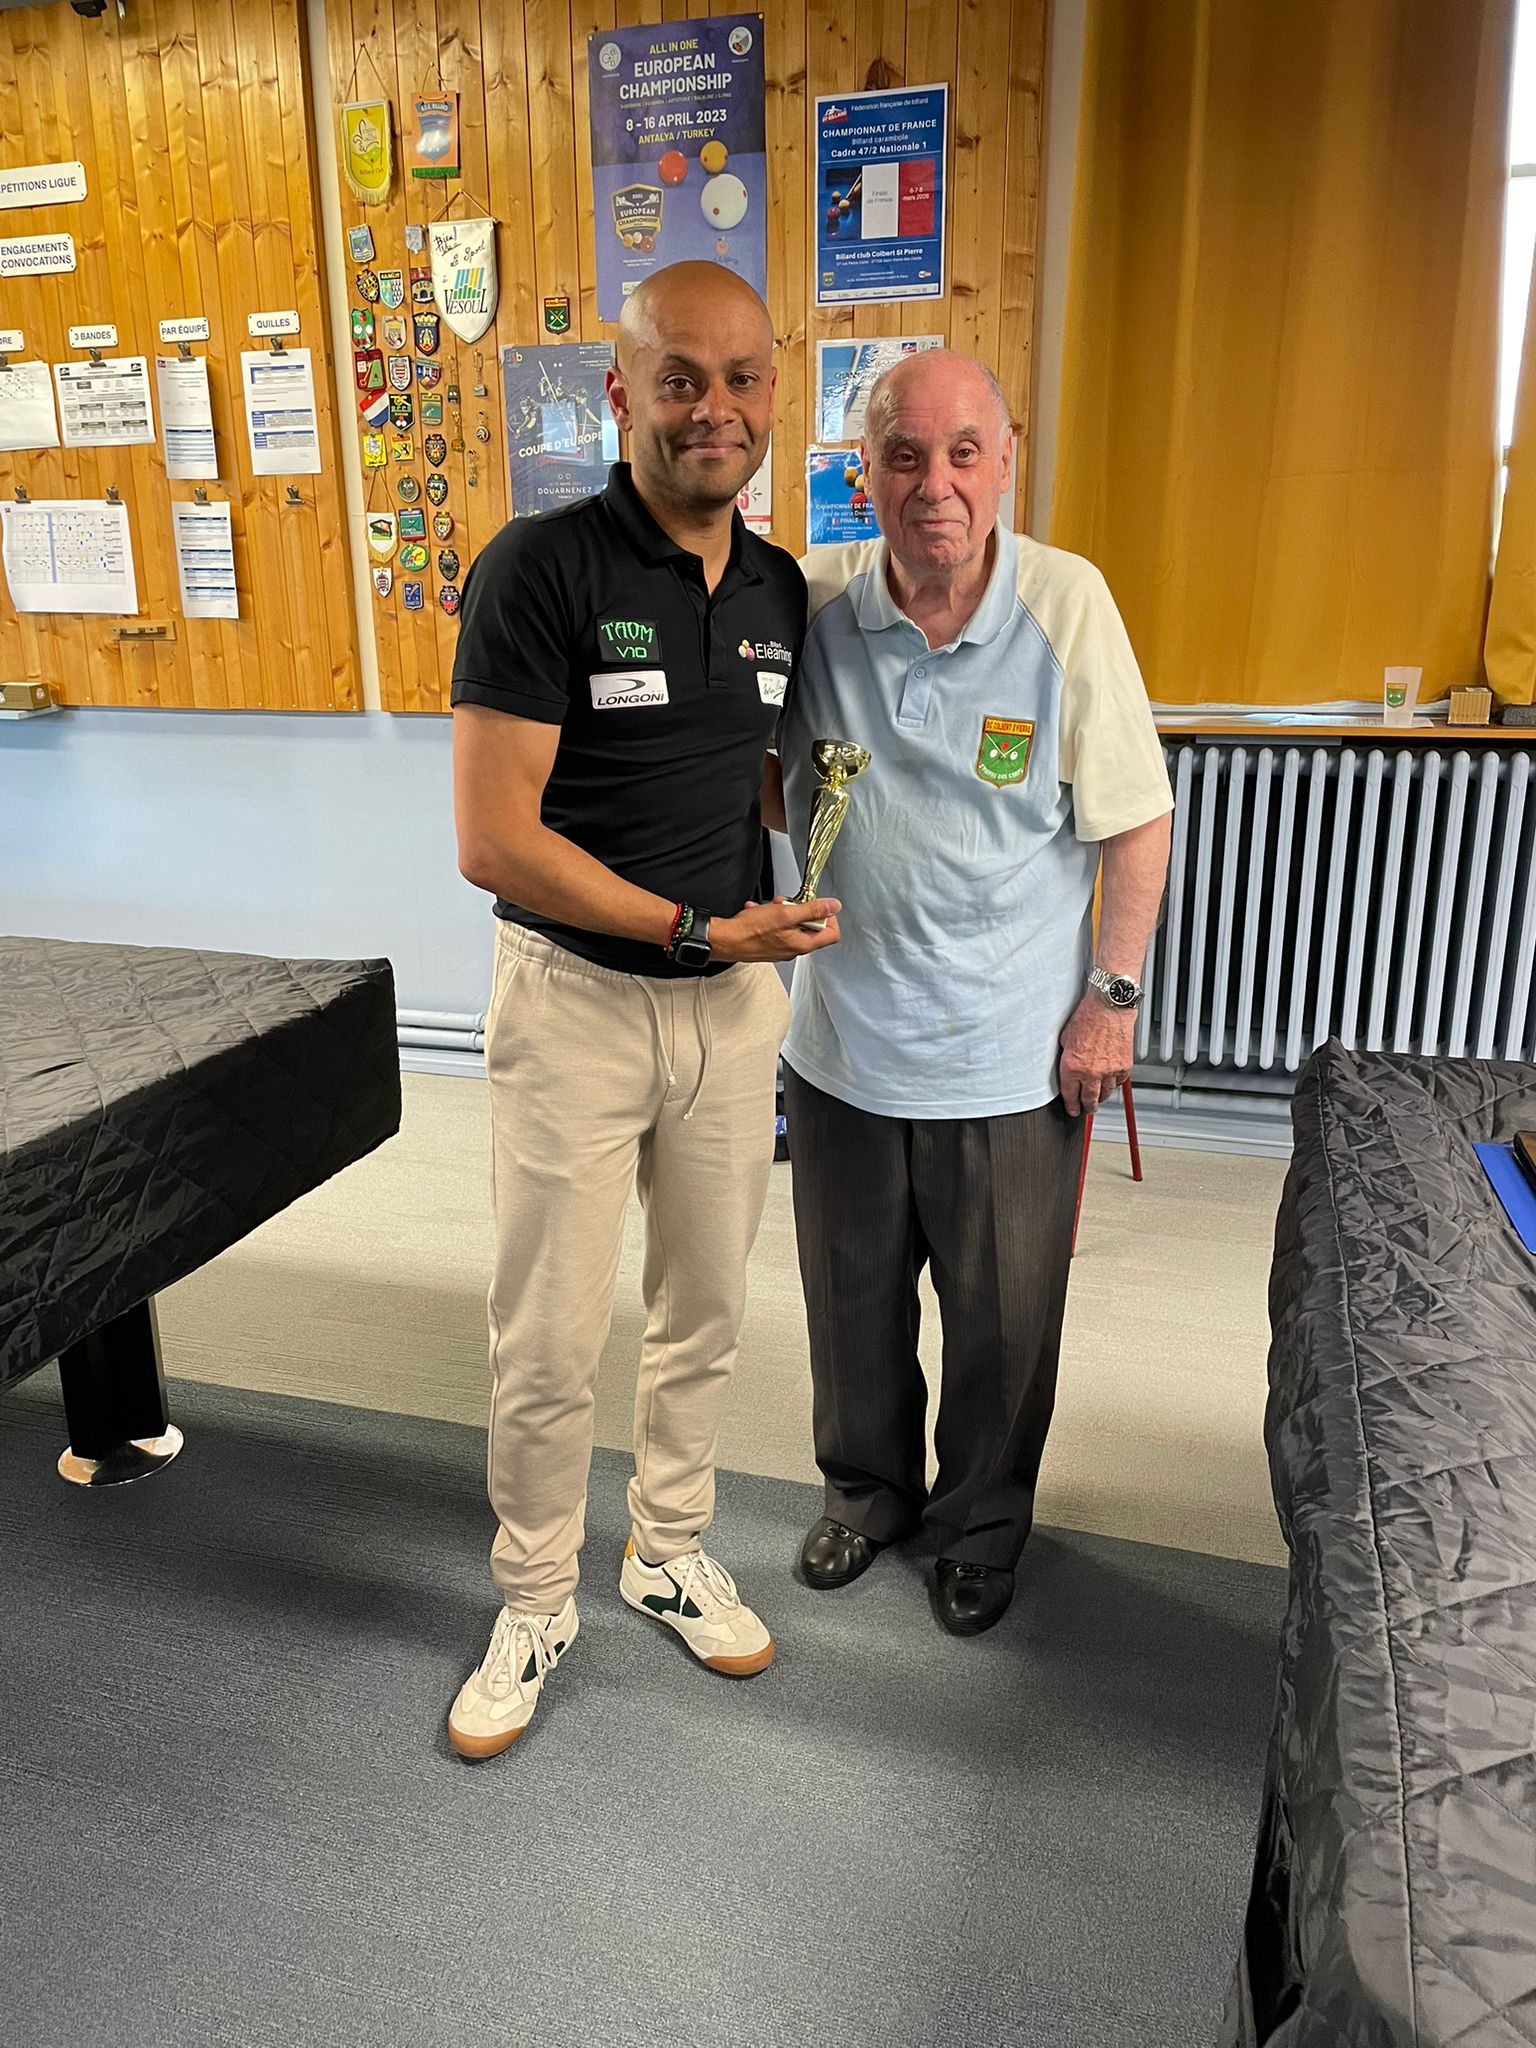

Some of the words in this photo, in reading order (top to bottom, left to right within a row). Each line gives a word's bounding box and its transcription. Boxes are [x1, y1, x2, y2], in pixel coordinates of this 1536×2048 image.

[649, 43, 667, 55] ALL
[669, 41, 678, 51] IN
[680, 39, 698, 50] ONE
[634, 53, 715, 78] EUROPEAN
[619, 73, 732, 100] CHAMPIONSHIP
[626, 119, 633, 131] 8
[644, 117, 655, 129] 16
[658, 113, 693, 128] APRIL
[697, 109, 727, 123] 2023
[823, 125, 886, 138] CHAMPIONNAT
[889, 124, 900, 132] DE
[902, 119, 937, 130] FRANCE
[638, 132, 675, 144] ANTALYA
[682, 128, 715, 139] TURKEY
[852, 137, 873, 145] Billard
[874, 134, 908, 144] carambole
[831, 149, 856, 158] Cadre
[858, 147, 877, 155] 47/2
[880, 143, 920, 154] Nationale
[0, 179, 47, 193] PÉTITIONS
[49, 177, 77, 188] LIGUE
[620, 207, 657, 217] EUROPEAN
[1, 242, 69, 256] ENGAGEMENTS
[835, 252, 856, 260] Billard
[872, 249, 895, 258] Colbert
[1, 255, 72, 269] CONVOCATIONS
[444, 288, 488, 315] VESOUL
[161, 327, 177, 336] PAR
[178, 323, 208, 334] ÉQUIPE
[256, 318, 291, 329] QUILLES
[80, 331, 112, 340] BANDES
[518, 442, 553, 458] COUPE
[554, 431, 603, 450] D'EUROPE
[537, 487, 592, 495] DOUARNENEZ
[601, 621, 654, 643] TAOM
[616, 646, 648, 659] V10
[597, 693, 664, 706] LONGONI
